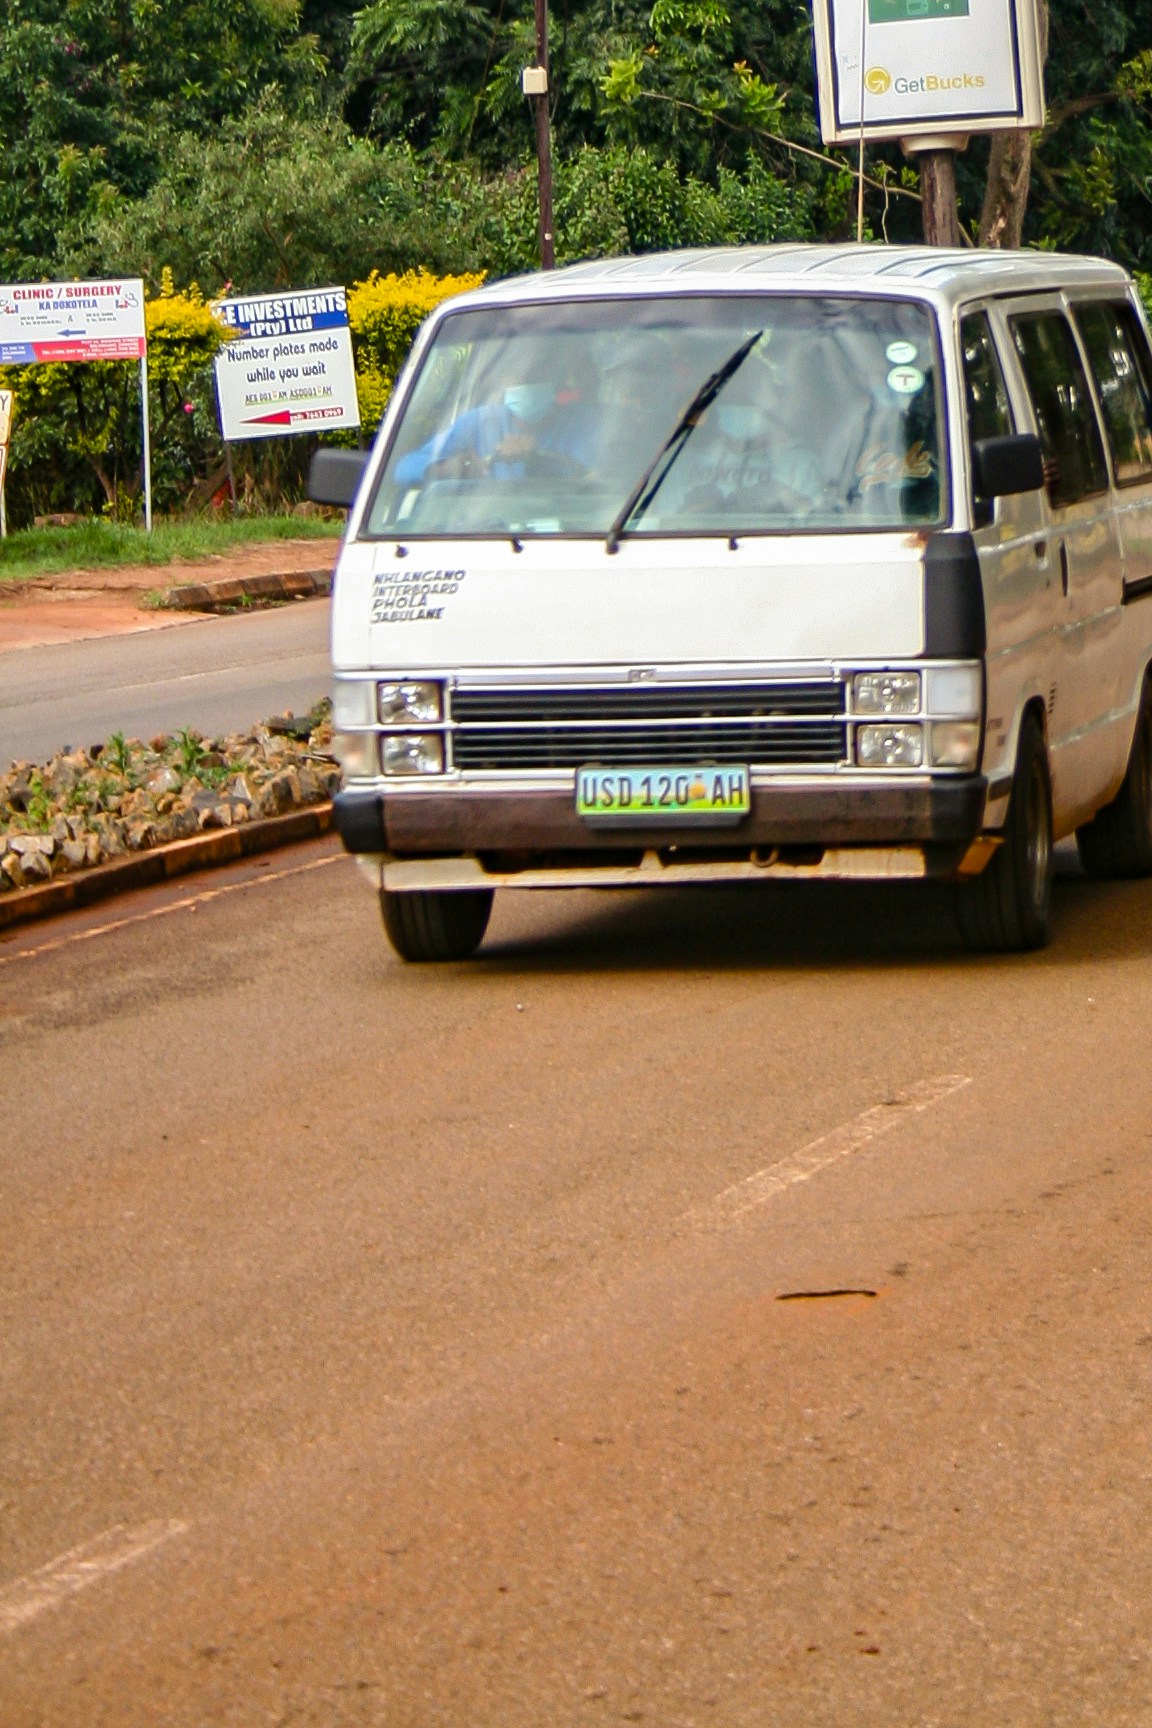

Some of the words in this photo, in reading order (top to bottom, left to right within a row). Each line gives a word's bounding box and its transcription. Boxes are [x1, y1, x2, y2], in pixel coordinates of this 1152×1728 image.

[894, 73, 986, 94] GetBucks
[13, 288, 54, 300] CLINIC
[66, 285, 122, 298] SURGERY
[39, 301, 51, 310] KA
[238, 292, 346, 323] INVESTMENTS
[250, 320, 285, 336] (Pty)
[289, 317, 313, 331] Ltd
[228, 346, 269, 362] Number
[273, 343, 305, 361] plates
[309, 337, 338, 351] made
[247, 367, 275, 382] while
[279, 368, 299, 382] you
[302, 361, 326, 375] wait
[372, 594, 427, 611] PHOLA
[583, 777, 632, 807] USD
[641, 775, 689, 806] 120
[712, 774, 743, 805] AH
